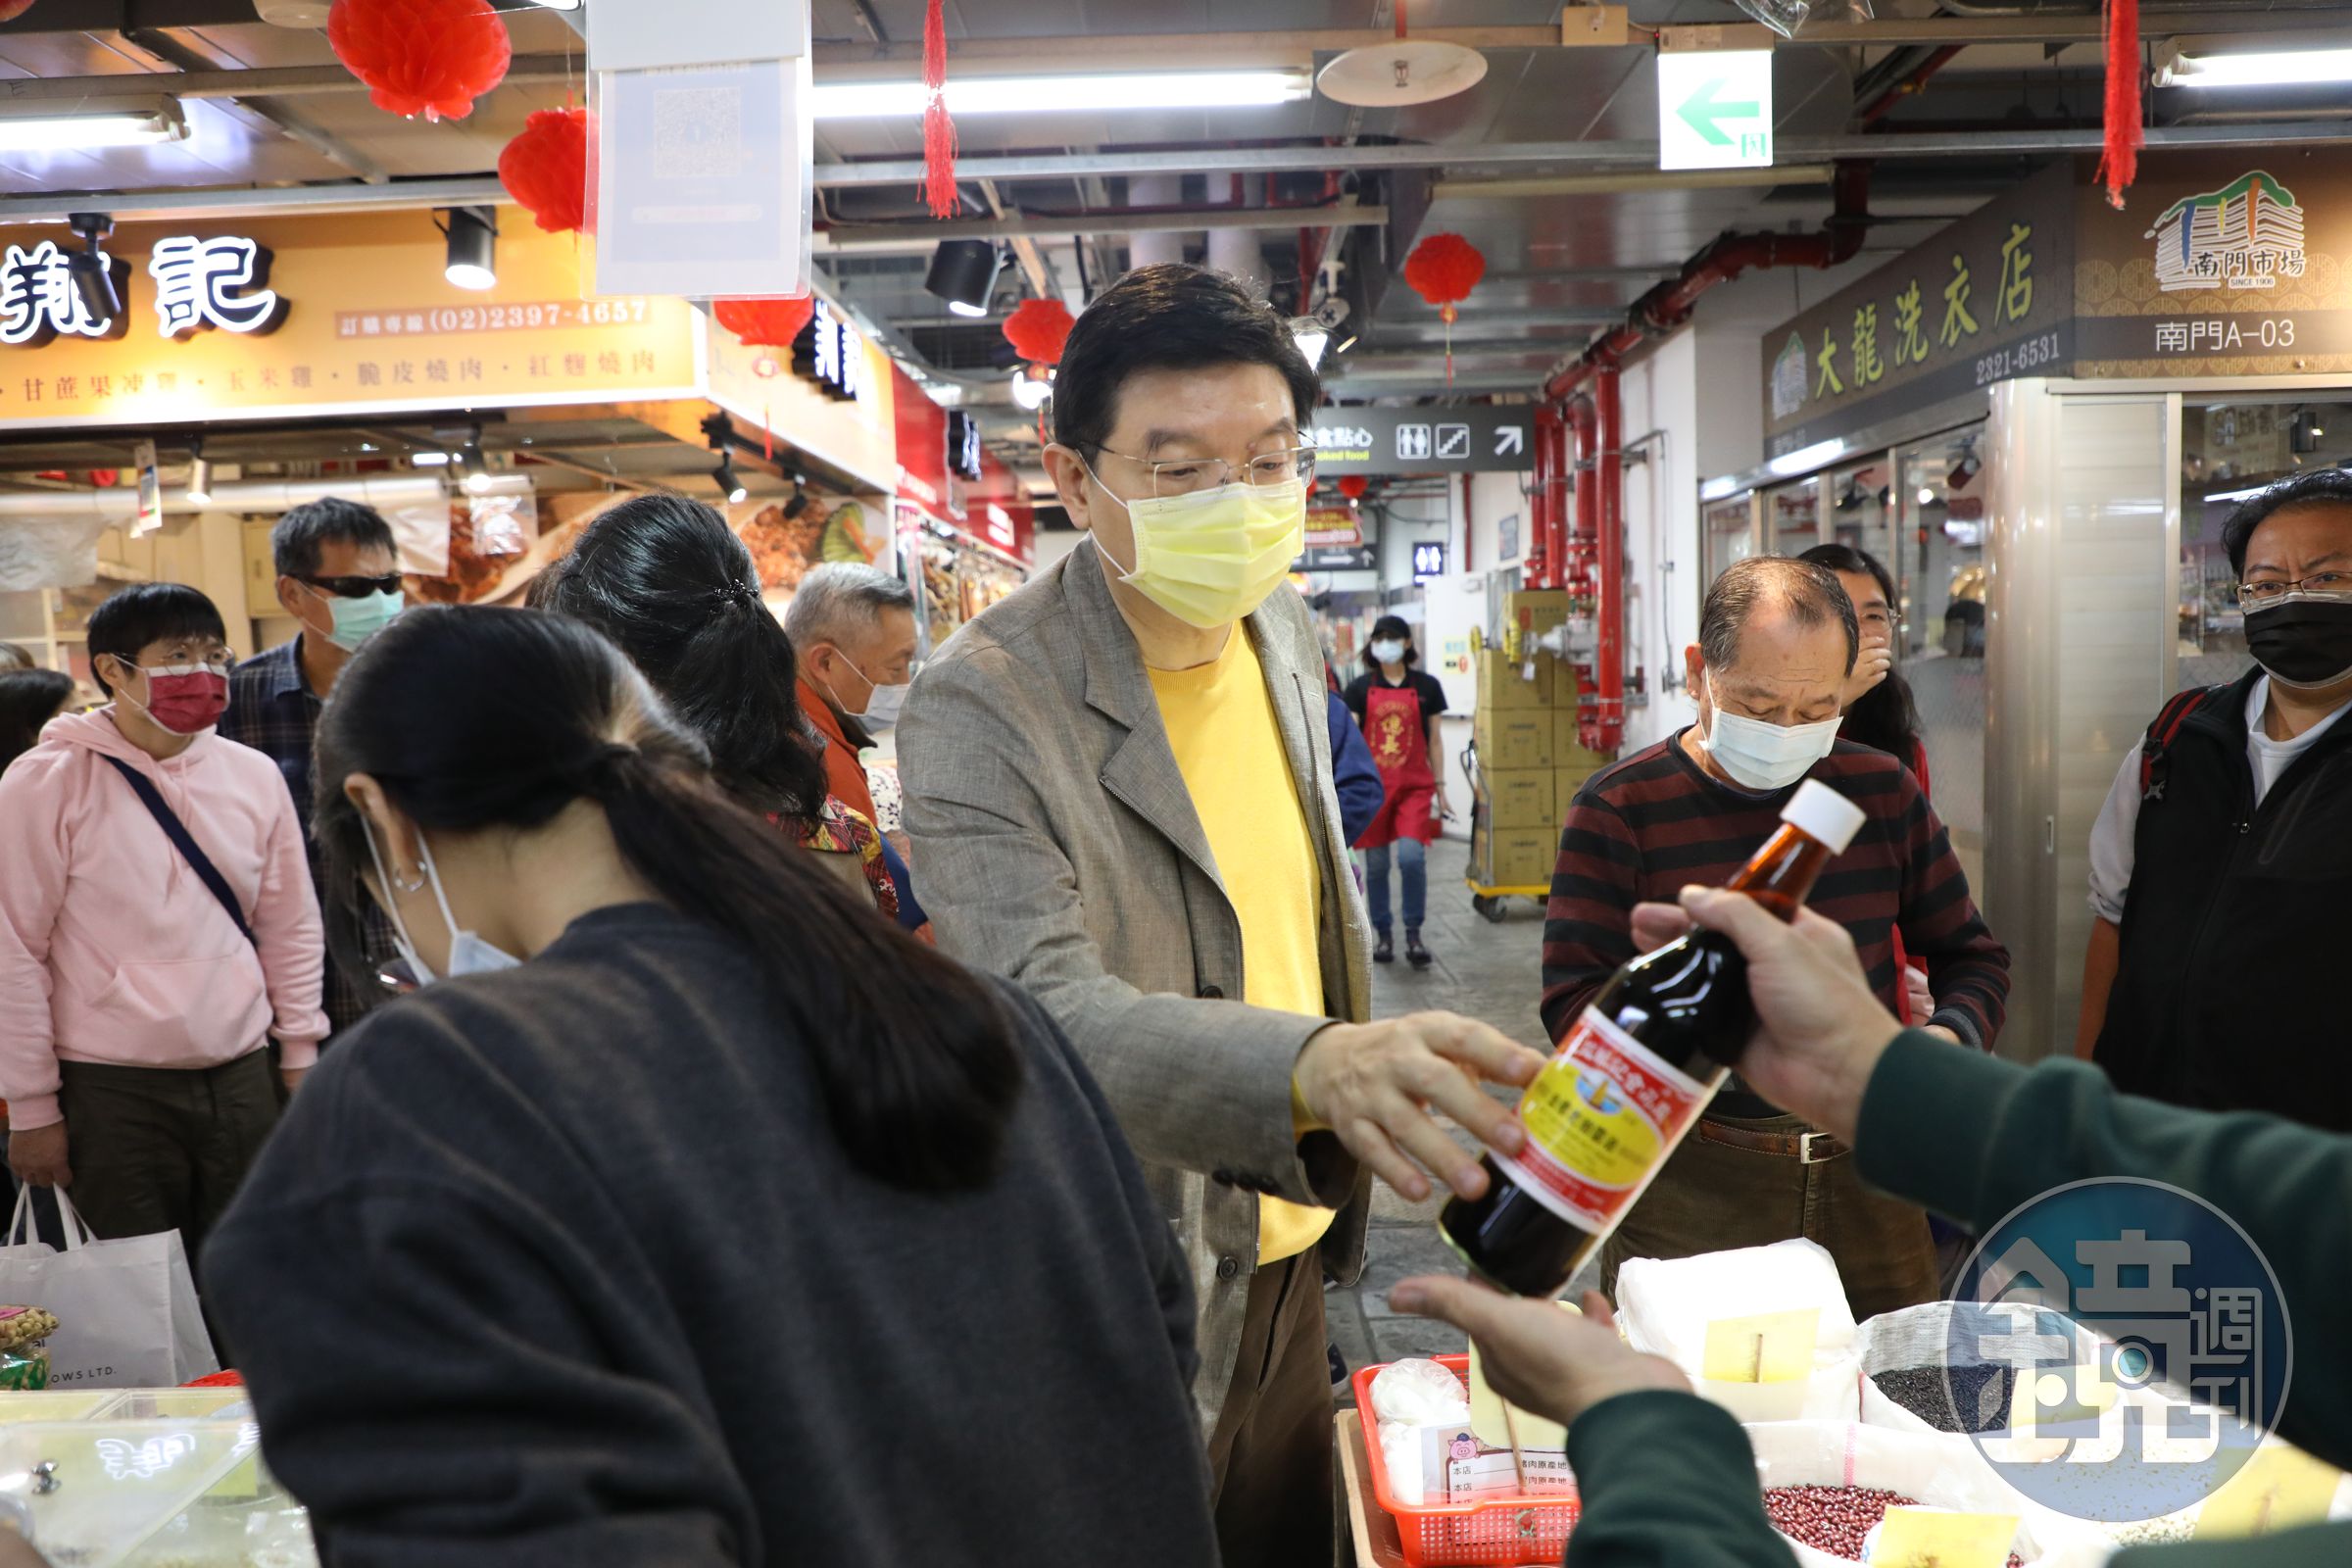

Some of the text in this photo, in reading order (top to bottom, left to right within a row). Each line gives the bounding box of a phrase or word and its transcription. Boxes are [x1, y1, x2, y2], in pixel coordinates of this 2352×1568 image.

[2193, 249, 2306, 276] 南門市場
[2230, 276, 2275, 287] SINCE 1906
[1816, 223, 2034, 400] 大龍洗衣店
[2155, 318, 2295, 351] 南門A-03
[1976, 333, 2060, 384] 2321-6531
[50, 1366, 117, 1384] OWS LTD.
[1453, 1466, 1472, 1475] 本店
[1525, 1476, 1567, 1485] 肉原產地
